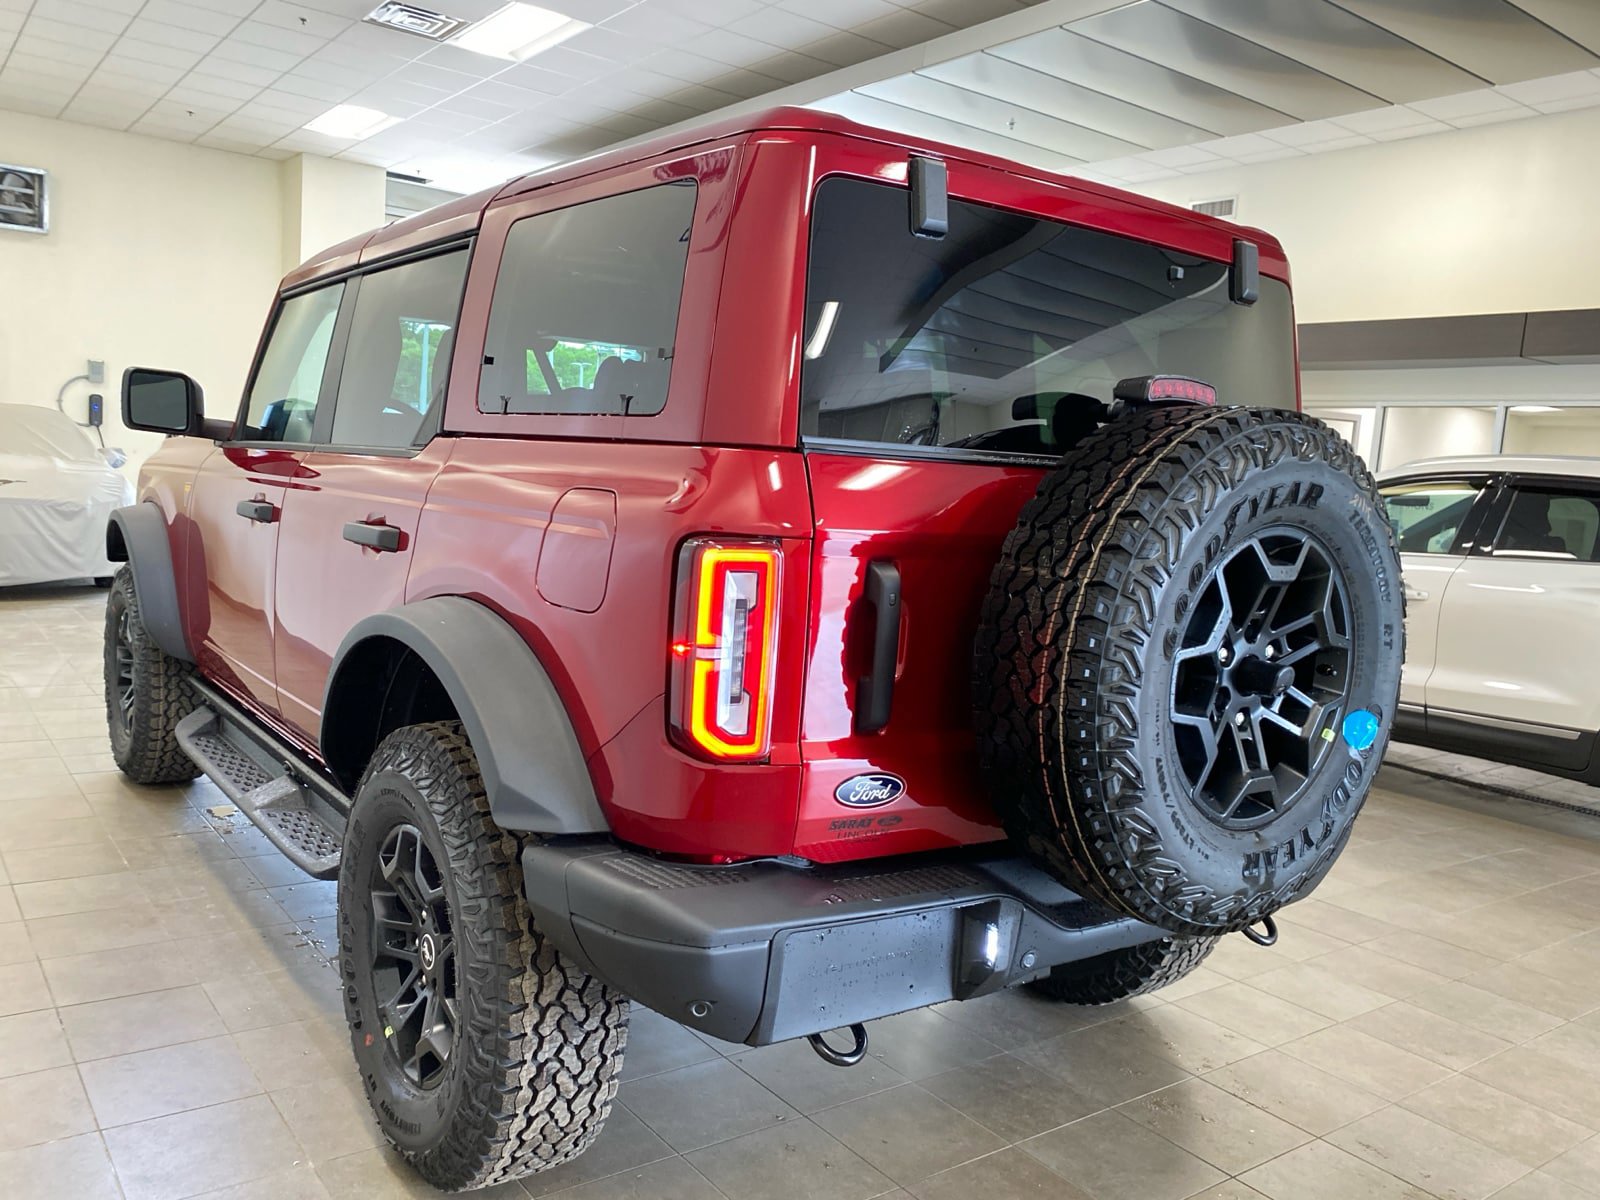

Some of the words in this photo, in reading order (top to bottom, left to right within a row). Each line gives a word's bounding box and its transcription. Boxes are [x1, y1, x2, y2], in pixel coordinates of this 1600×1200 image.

[1163, 481, 1324, 660] GOODYEAR
[1348, 509, 1392, 603] TERRITORY
[1383, 623, 1393, 650] RT
[849, 780, 892, 802] Ford
